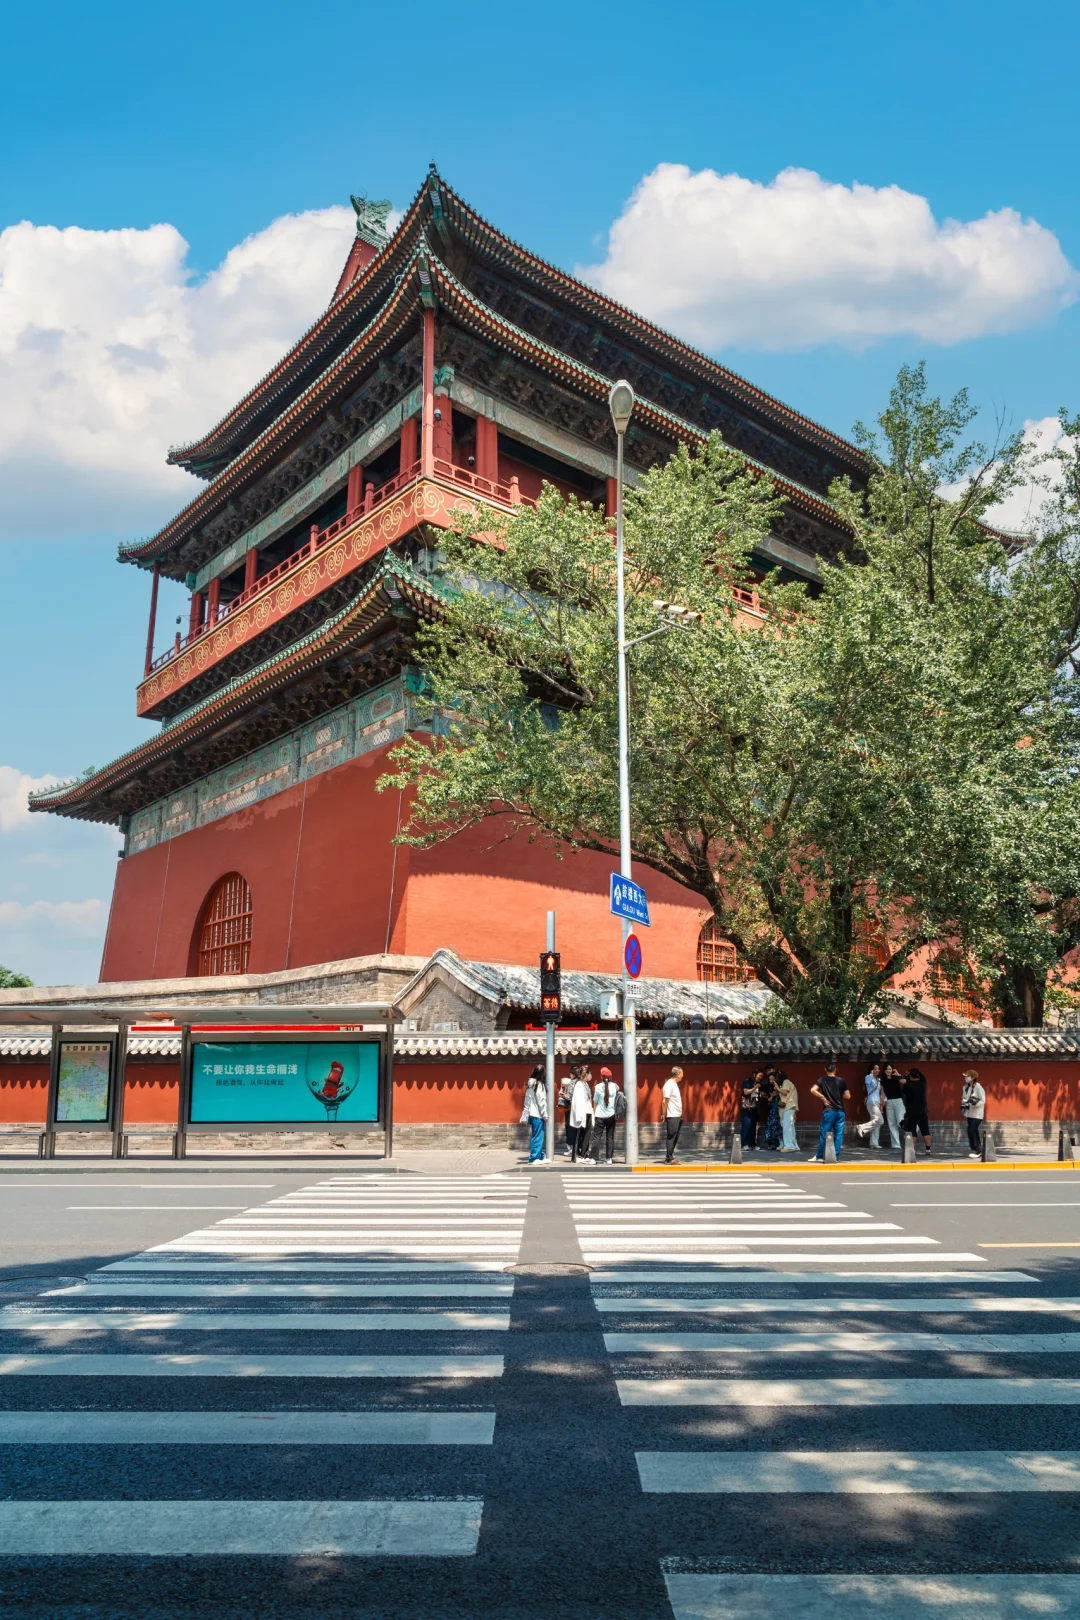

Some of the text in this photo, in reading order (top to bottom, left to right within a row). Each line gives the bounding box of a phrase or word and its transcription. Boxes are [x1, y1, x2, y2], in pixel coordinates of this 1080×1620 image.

[622, 902, 636, 915] GULOU
[543, 997, 559, 1009] 等待
[202, 1064, 299, 1076] 不要让你我生命搁浅
